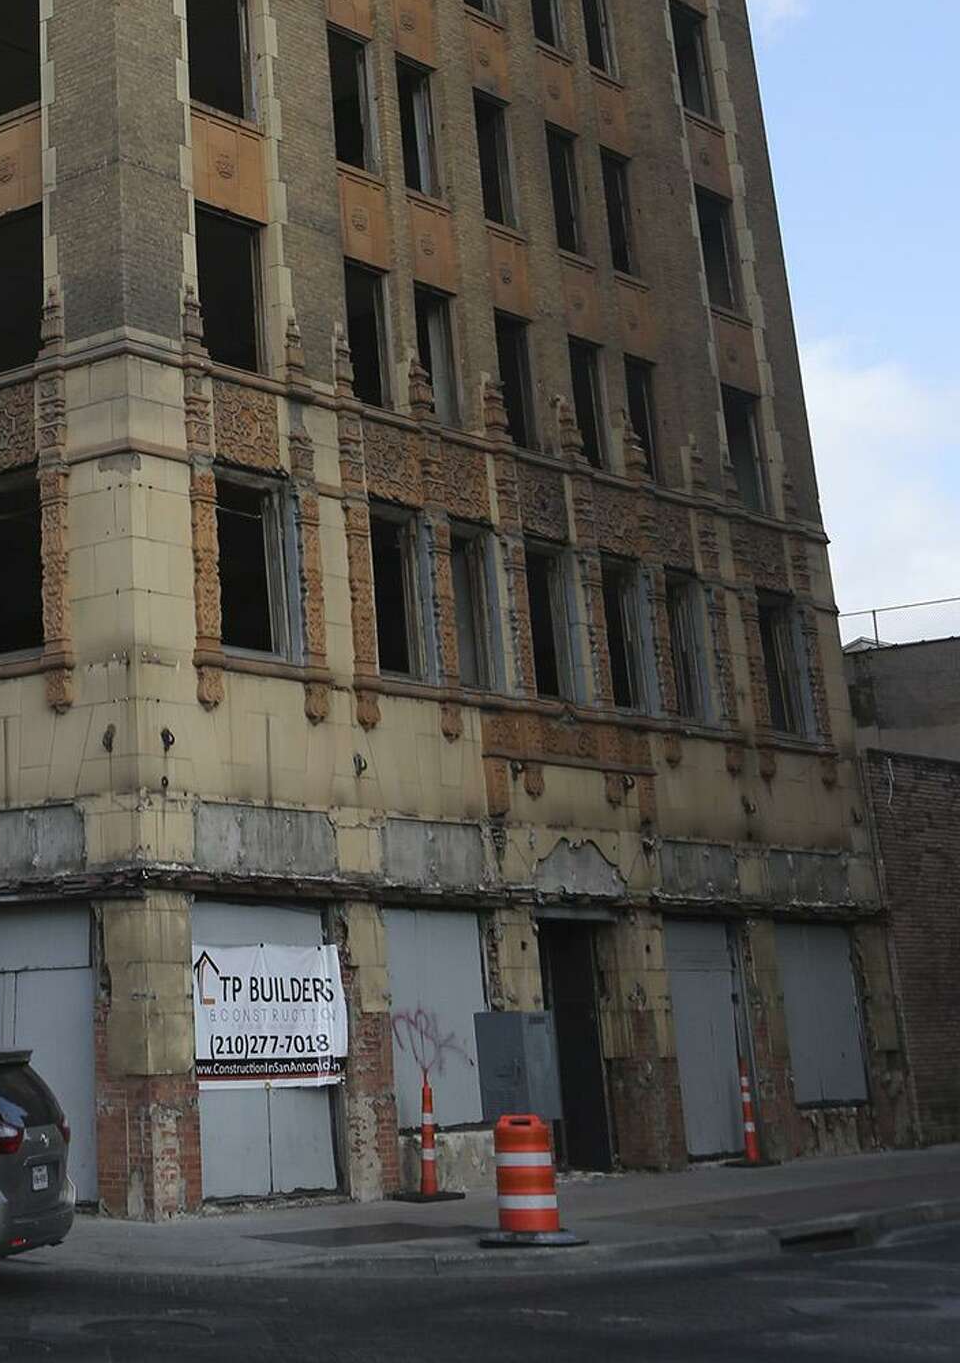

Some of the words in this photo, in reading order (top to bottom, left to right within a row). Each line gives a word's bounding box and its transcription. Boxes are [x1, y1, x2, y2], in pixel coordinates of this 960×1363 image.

[220, 976, 241, 1003] TP
[250, 976, 334, 1004] BUILDERS
[209, 1033, 330, 1060] (210)277-7018
